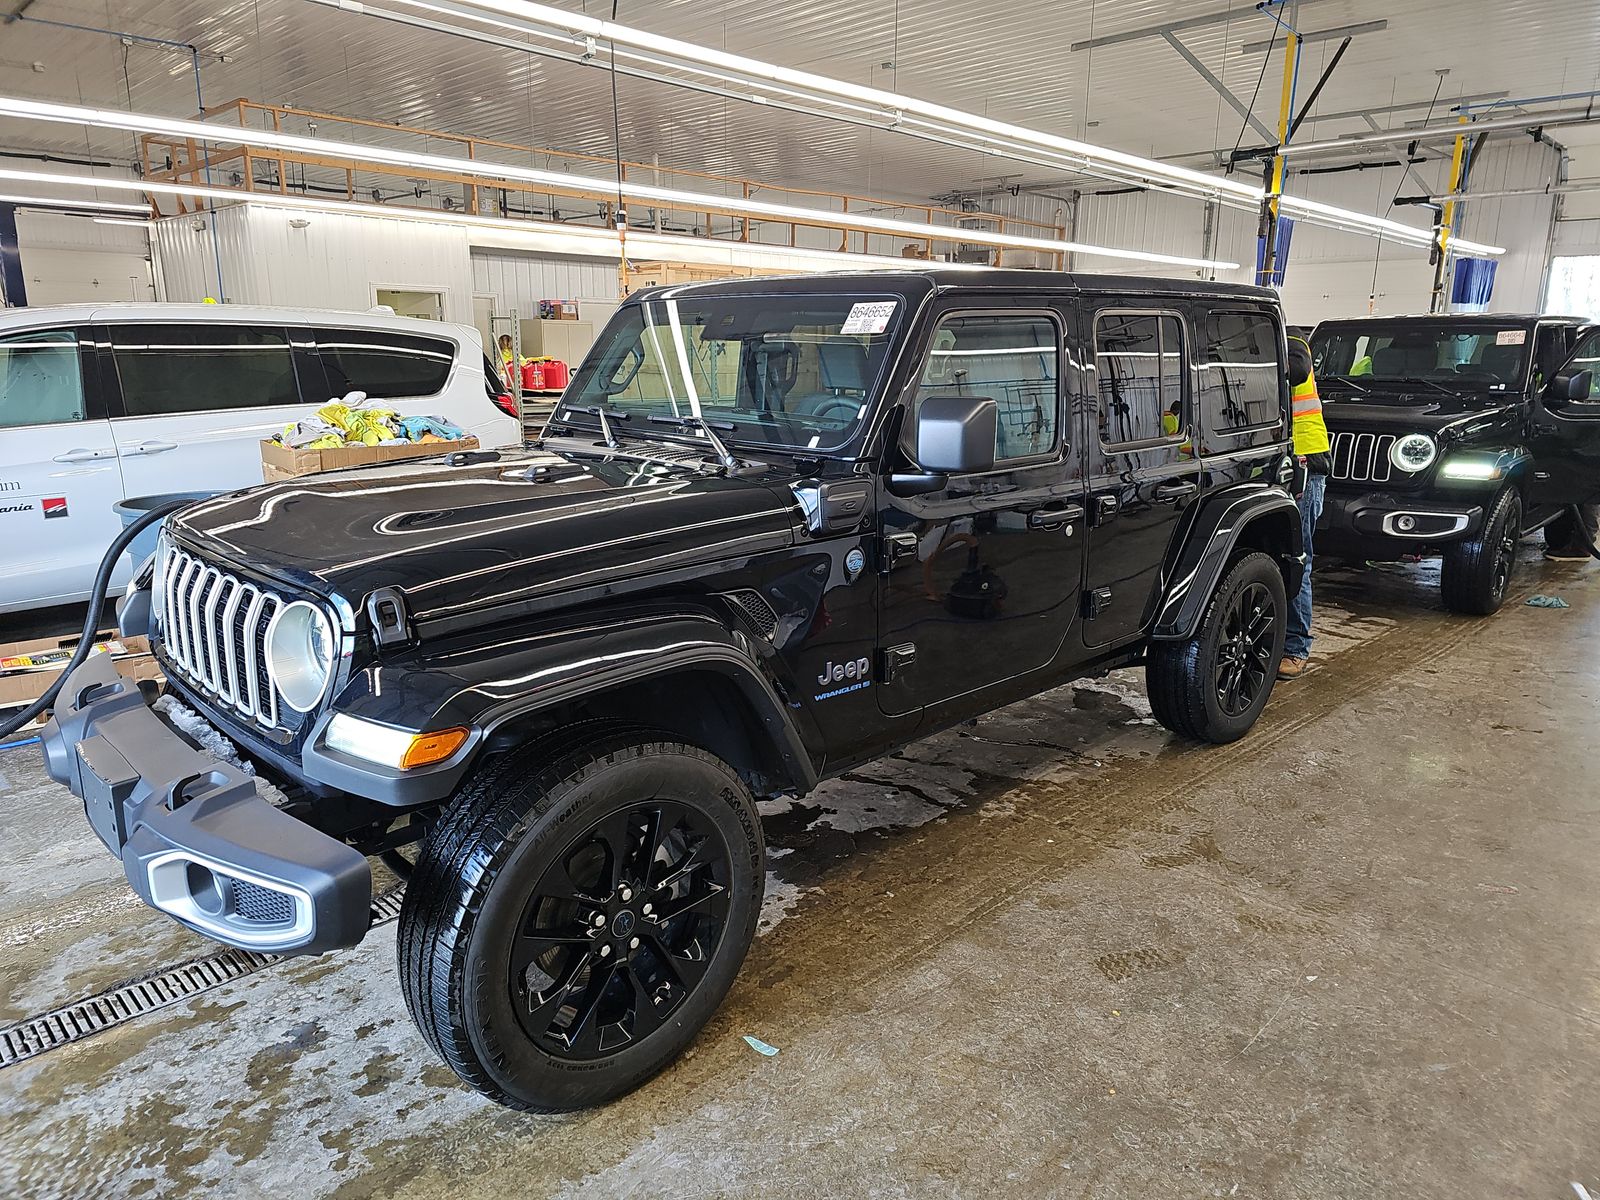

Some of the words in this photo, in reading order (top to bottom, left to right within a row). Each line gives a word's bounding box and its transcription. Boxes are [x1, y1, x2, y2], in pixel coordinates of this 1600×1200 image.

[850, 305, 895, 318] 8646652
[818, 657, 869, 685] Jeep
[814, 683, 862, 701] WRANGLER
